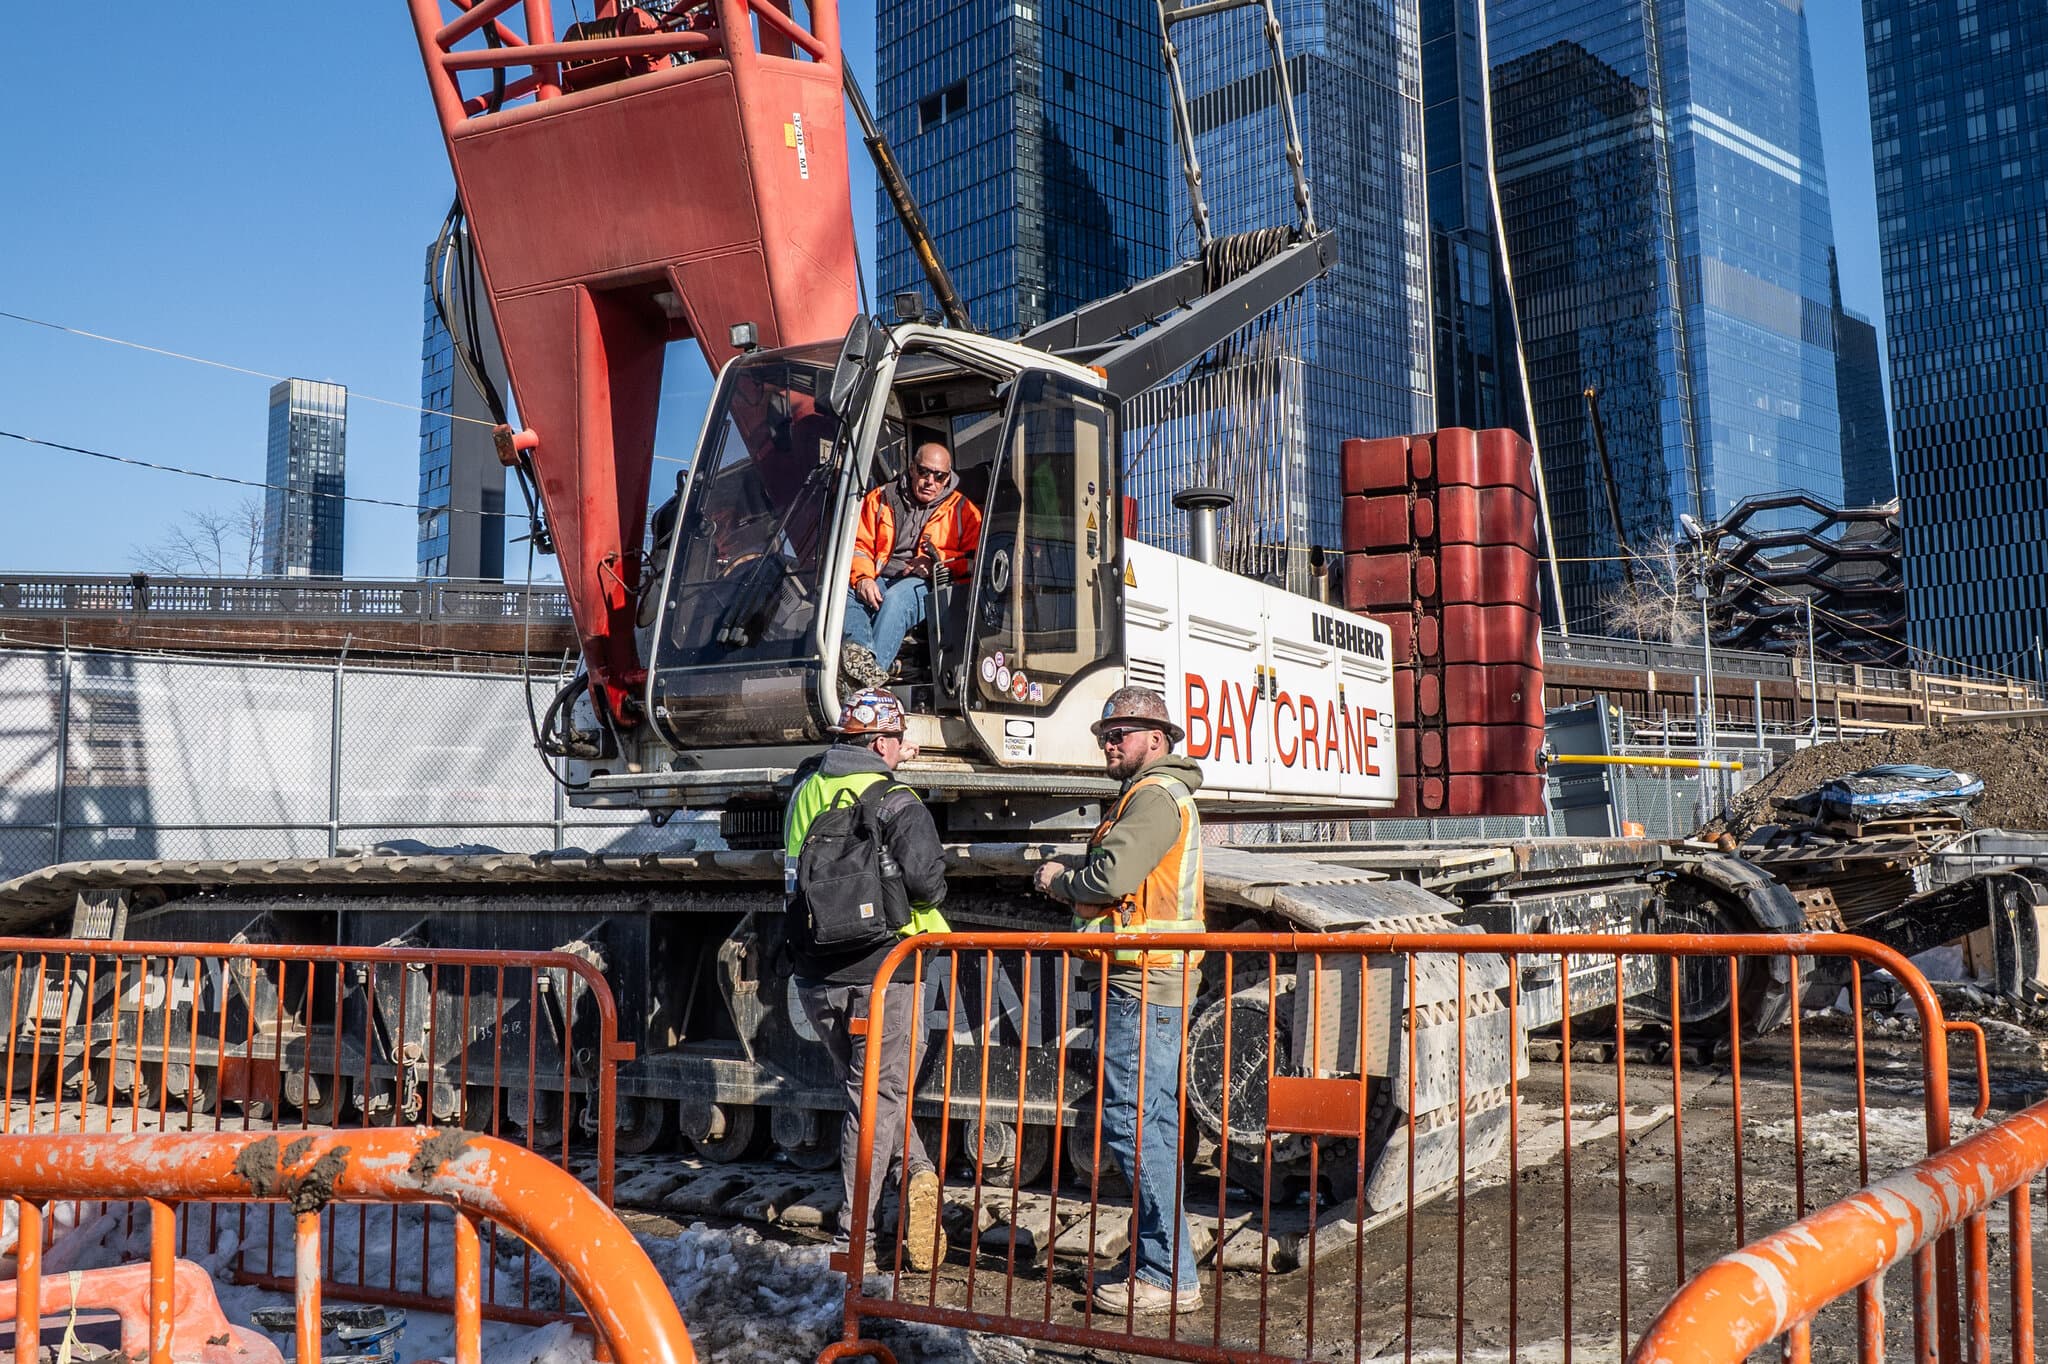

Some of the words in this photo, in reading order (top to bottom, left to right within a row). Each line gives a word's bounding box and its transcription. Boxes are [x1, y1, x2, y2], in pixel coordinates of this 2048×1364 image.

[1312, 612, 1384, 661] LIEBHERR
[1185, 672, 1259, 765] BAY
[1273, 691, 1380, 777] CRANE
[129, 955, 233, 1013] BAY
